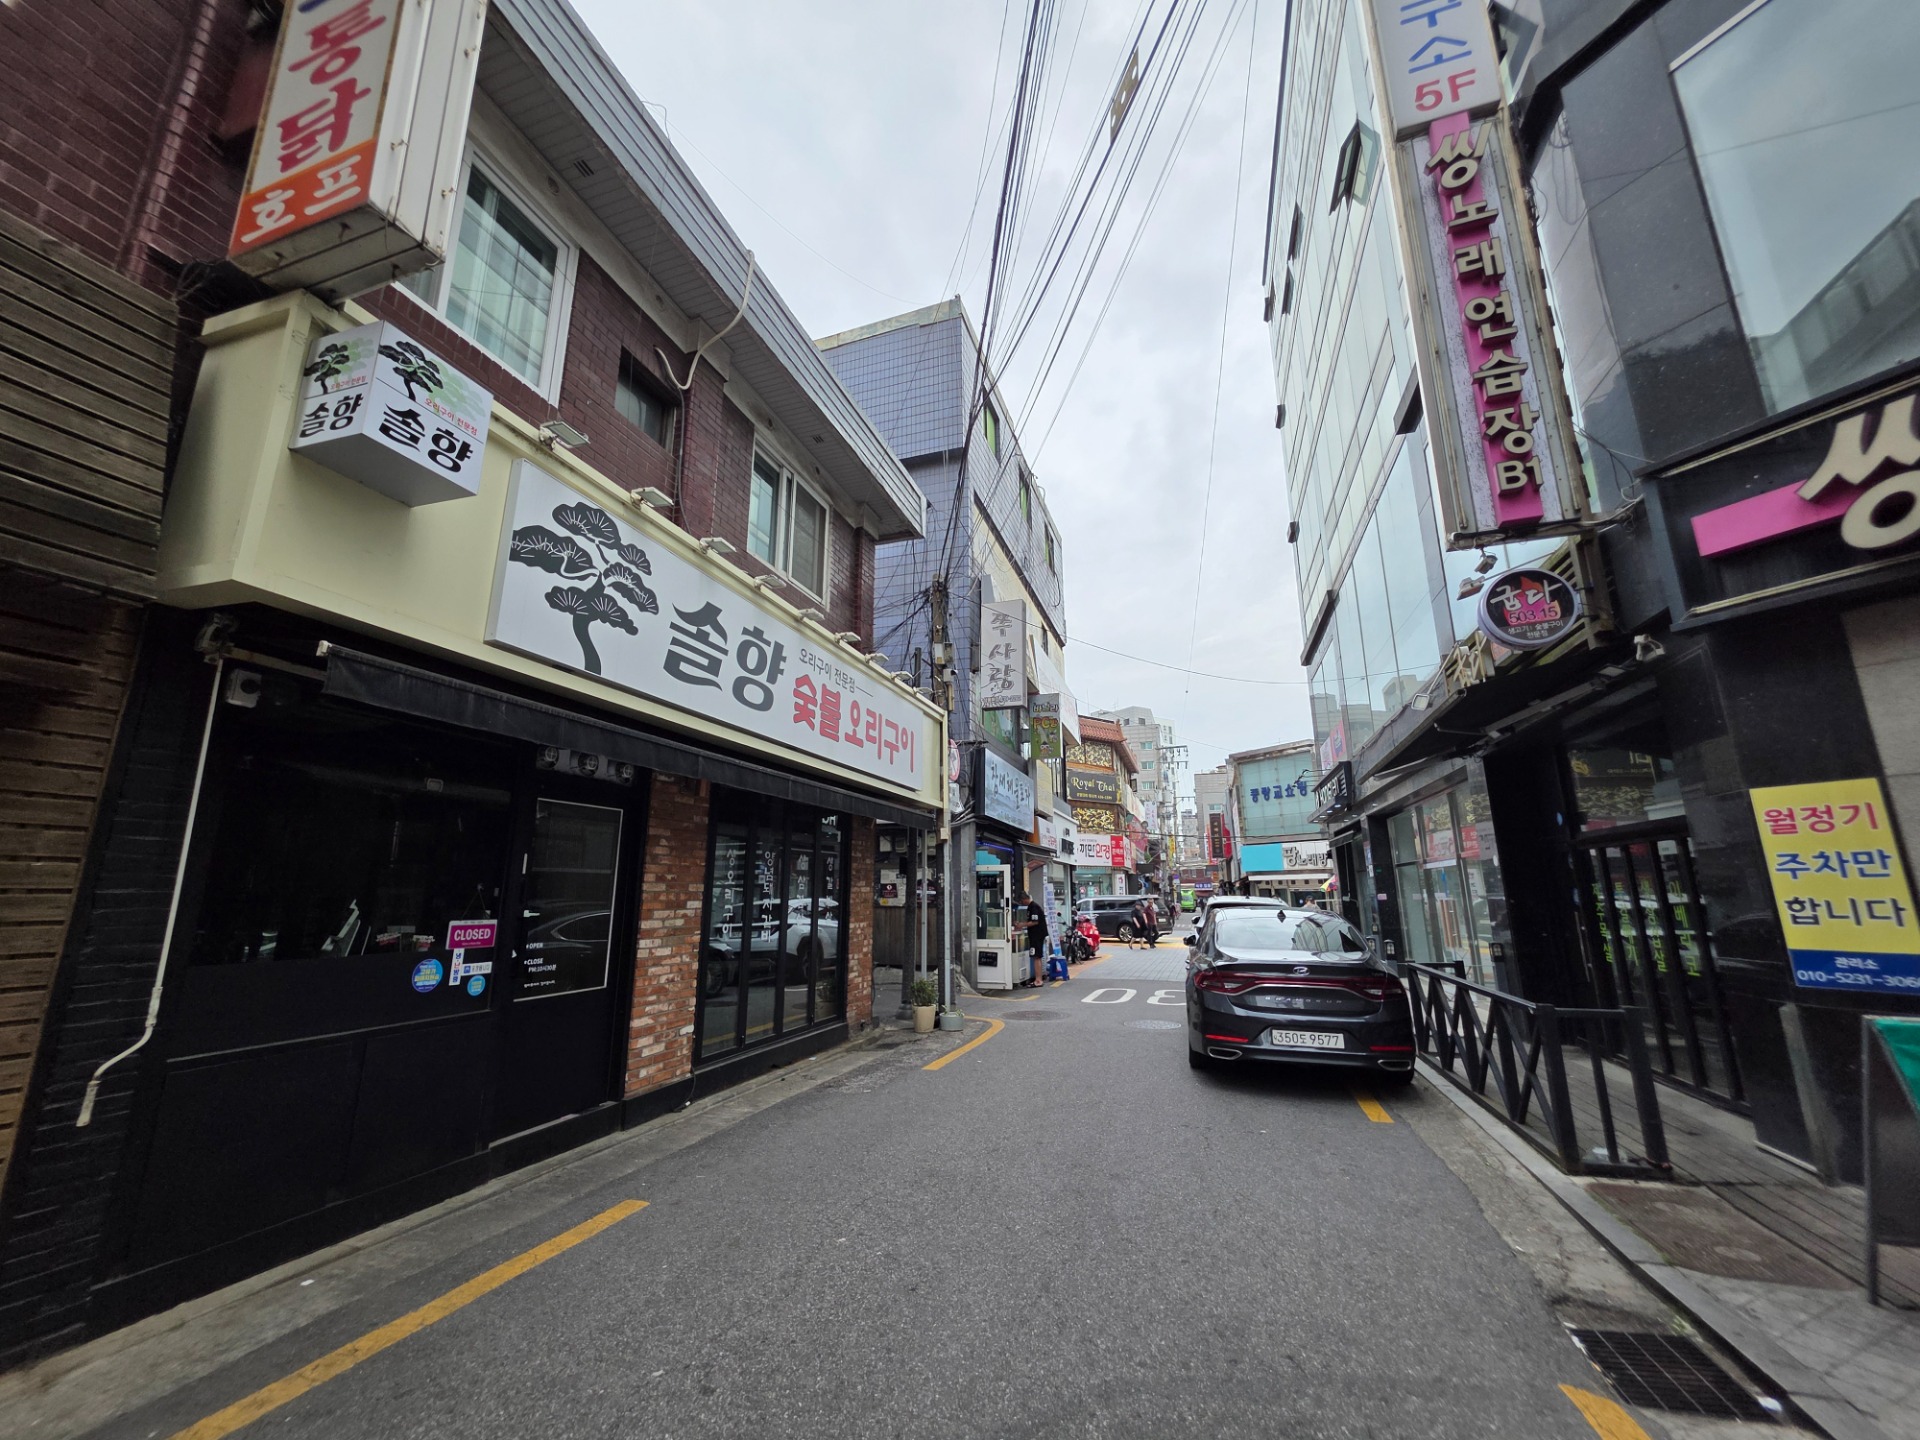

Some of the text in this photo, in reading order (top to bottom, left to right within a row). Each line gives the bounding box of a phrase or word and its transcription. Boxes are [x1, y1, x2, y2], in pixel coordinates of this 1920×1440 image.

[277, 0, 386, 173] 통닭
[1415, 68, 1476, 112] 5F
[241, 154, 361, 243] 호프
[1426, 122, 1543, 491] 씽노래연습장 B1
[299, 392, 363, 438] 솔향
[424, 397, 478, 436] 오리구이 전문점
[378, 402, 473, 473] 솔향
[1509, 606, 1558, 623] 503.15
[1534, 620, 1564, 631] 숯불구이
[1526, 630, 1549, 639] 전문점
[663, 600, 787, 712] 솔향
[798, 647, 856, 698] 오리구이 전문점
[792, 673, 915, 773] 숯불 오리구이
[1071, 776, 1116, 792] Royal Thai
[1250, 781, 1308, 803] 중랑교쇼핑
[1763, 802, 1880, 836] 월정기
[1774, 848, 1893, 881] 주차만
[1784, 896, 1907, 928] 합니다
[454, 928, 491, 942] CLOSED
[1797, 970, 1920, 989] 010-5231-306
[1834, 956, 1880, 970] 관리소
[1309, 1034, 1339, 1047] 9577
